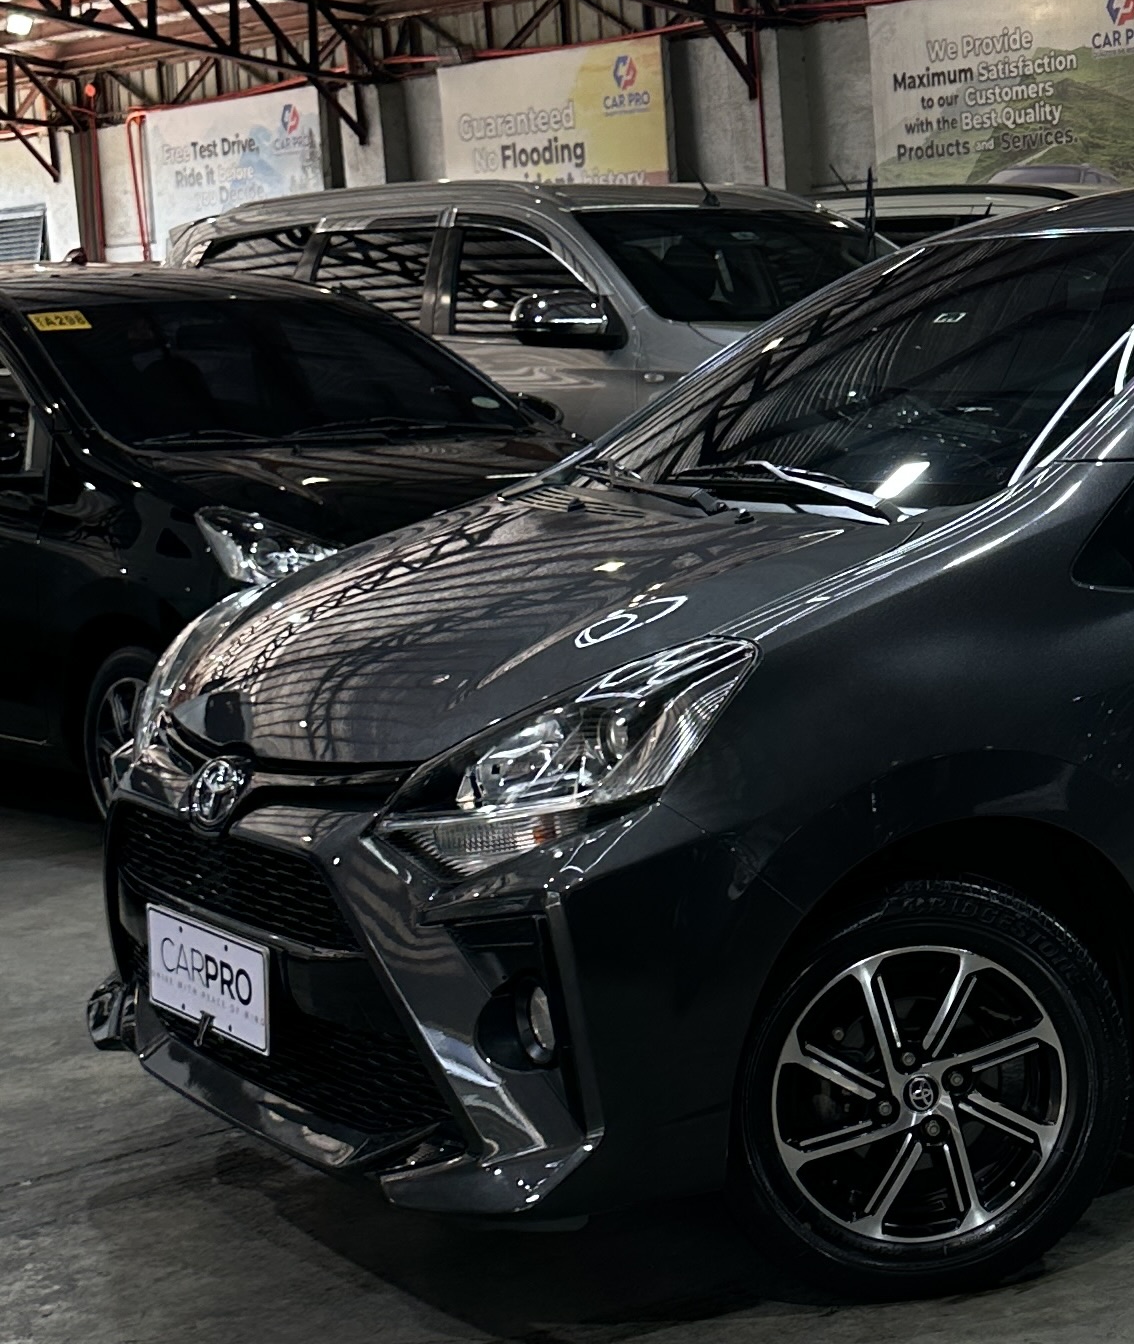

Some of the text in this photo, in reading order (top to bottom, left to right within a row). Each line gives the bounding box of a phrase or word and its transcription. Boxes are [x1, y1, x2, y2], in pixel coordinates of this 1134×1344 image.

[927, 27, 1034, 62] We Provide
[1092, 31, 1121, 50] CAR
[893, 51, 1078, 92] Maximum Satisfaction
[603, 91, 650, 109] CAR PRO
[921, 79, 1054, 110] to our Customers
[459, 99, 575, 141] Guaranteed
[905, 102, 1063, 135] with the Best Quality
[162, 133, 260, 165] Free Test Drive,
[473, 138, 586, 173] No Flooding
[896, 126, 1079, 162] Products and Services.
[175, 167, 203, 188] Ride
[205, 165, 215, 184] it
